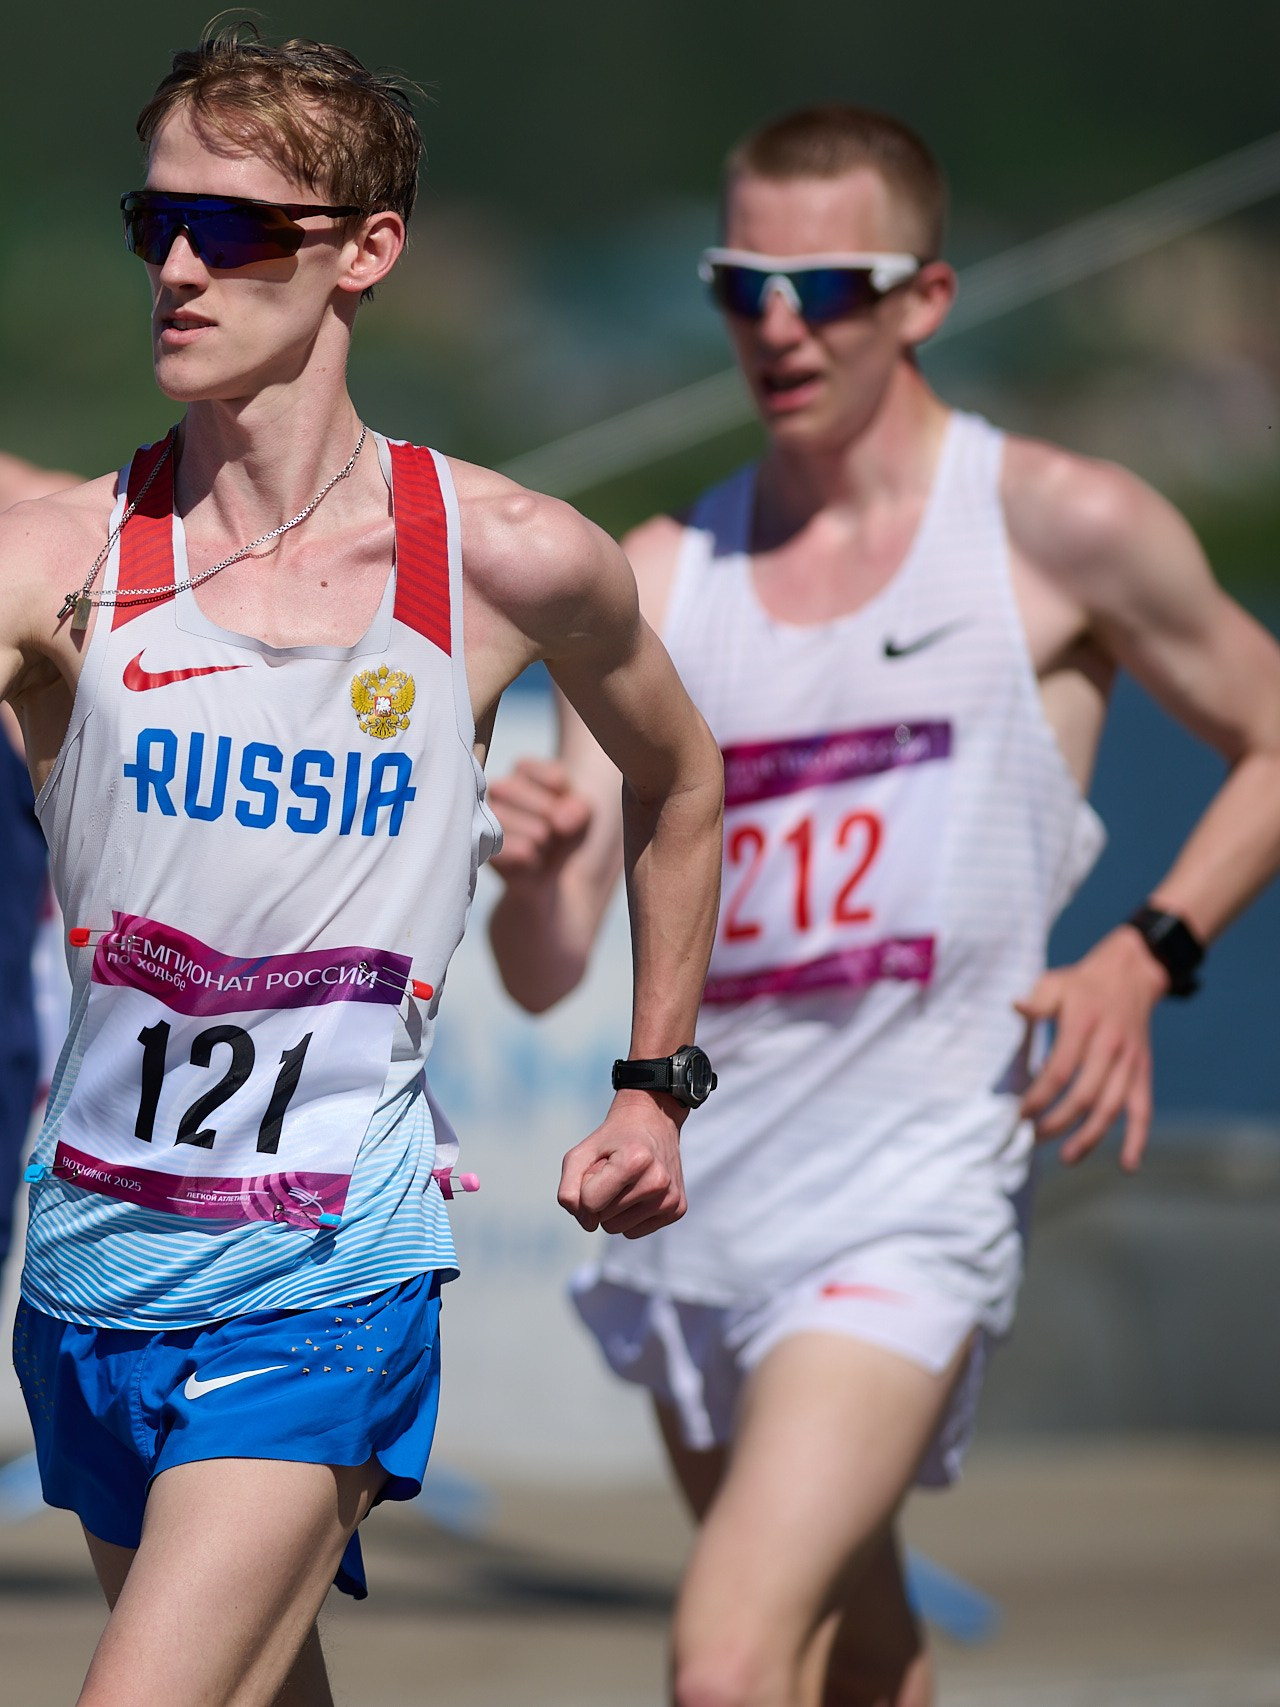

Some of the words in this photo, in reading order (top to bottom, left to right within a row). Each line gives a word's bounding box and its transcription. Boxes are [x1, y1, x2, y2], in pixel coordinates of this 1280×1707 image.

[124, 728, 416, 837] RUSSIA
[722, 809, 884, 944] 212
[106, 951, 131, 966] по
[137, 957, 187, 992] ходьбе
[111, 934, 259, 993] ЧЕМПИОНАТ
[265, 965, 379, 991] РОССИИ
[134, 1019, 314, 1155] 121
[62, 1156, 112, 1184] ВОТКИНСК
[114, 1176, 142, 1192] 2025
[186, 1191, 218, 1202] ЛЕГКОЙ
